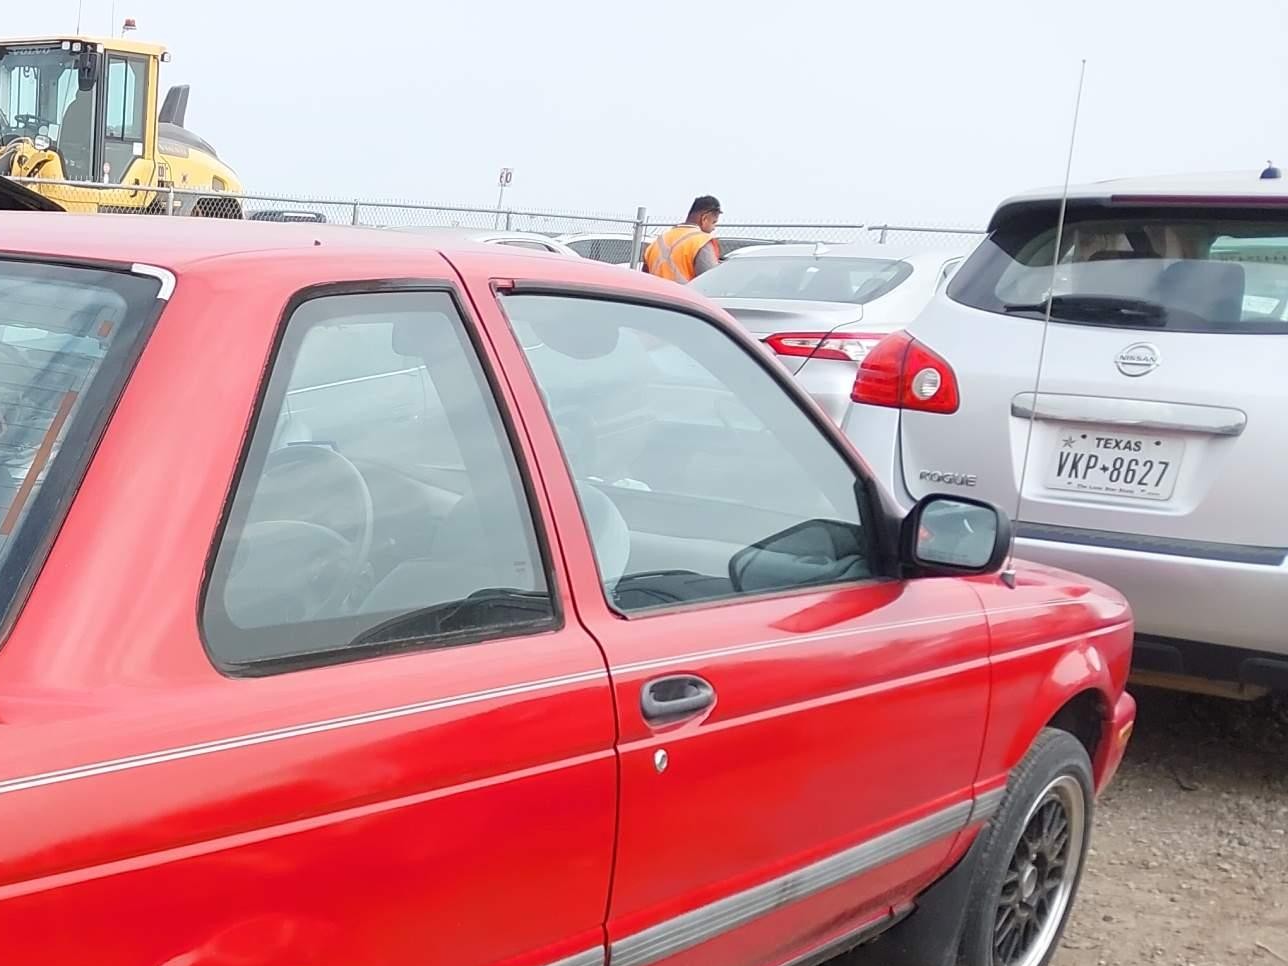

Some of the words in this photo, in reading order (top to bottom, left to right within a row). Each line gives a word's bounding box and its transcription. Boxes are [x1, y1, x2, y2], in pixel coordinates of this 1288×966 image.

[1119, 353, 1157, 363] NISSAN
[1095, 436, 1143, 453] TEXAS
[918, 468, 977, 487] ROGUE
